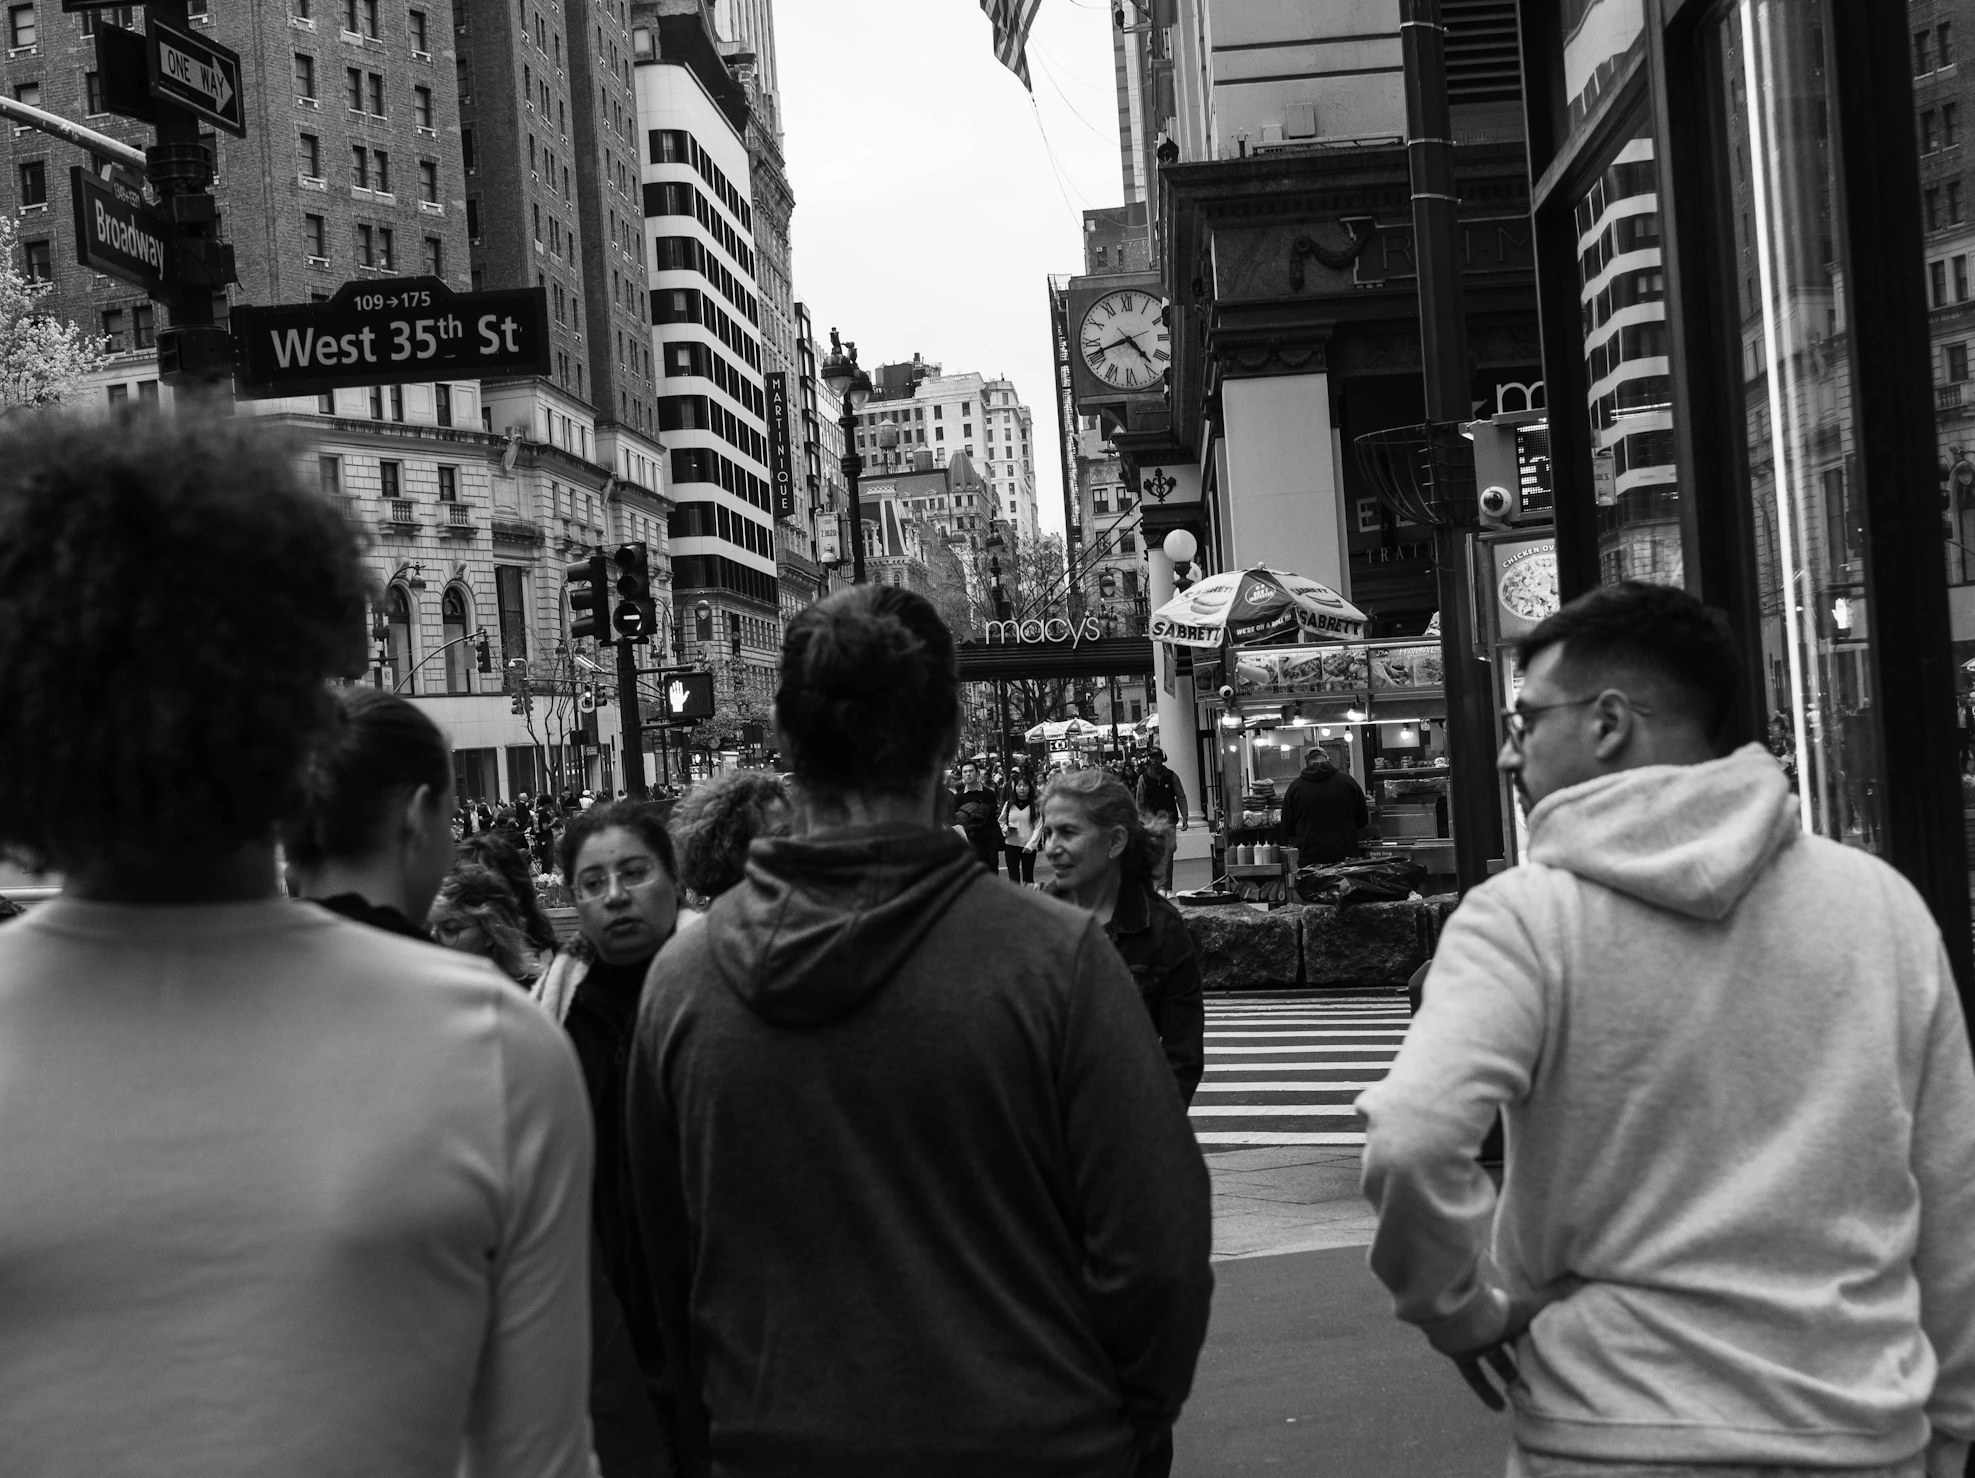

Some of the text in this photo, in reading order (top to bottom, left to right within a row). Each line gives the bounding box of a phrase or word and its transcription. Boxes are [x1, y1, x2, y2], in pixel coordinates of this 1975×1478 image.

[168, 49, 191, 83] ONE
[200, 66, 224, 99] WAY
[95, 198, 163, 280] Broadway
[354, 291, 431, 311] 109 175
[270, 314, 520, 369] West 35th St
[772, 378, 788, 509] MARTINIQUE
[1502, 546, 1540, 568] CHICKEN
[1152, 621, 1222, 641] SABRETT
[1256, 623, 1265, 631] ON
[1271, 617, 1284, 628] ROLL
[1300, 610, 1362, 636] SABRETT
[1398, 646, 1437, 656] HALAL
